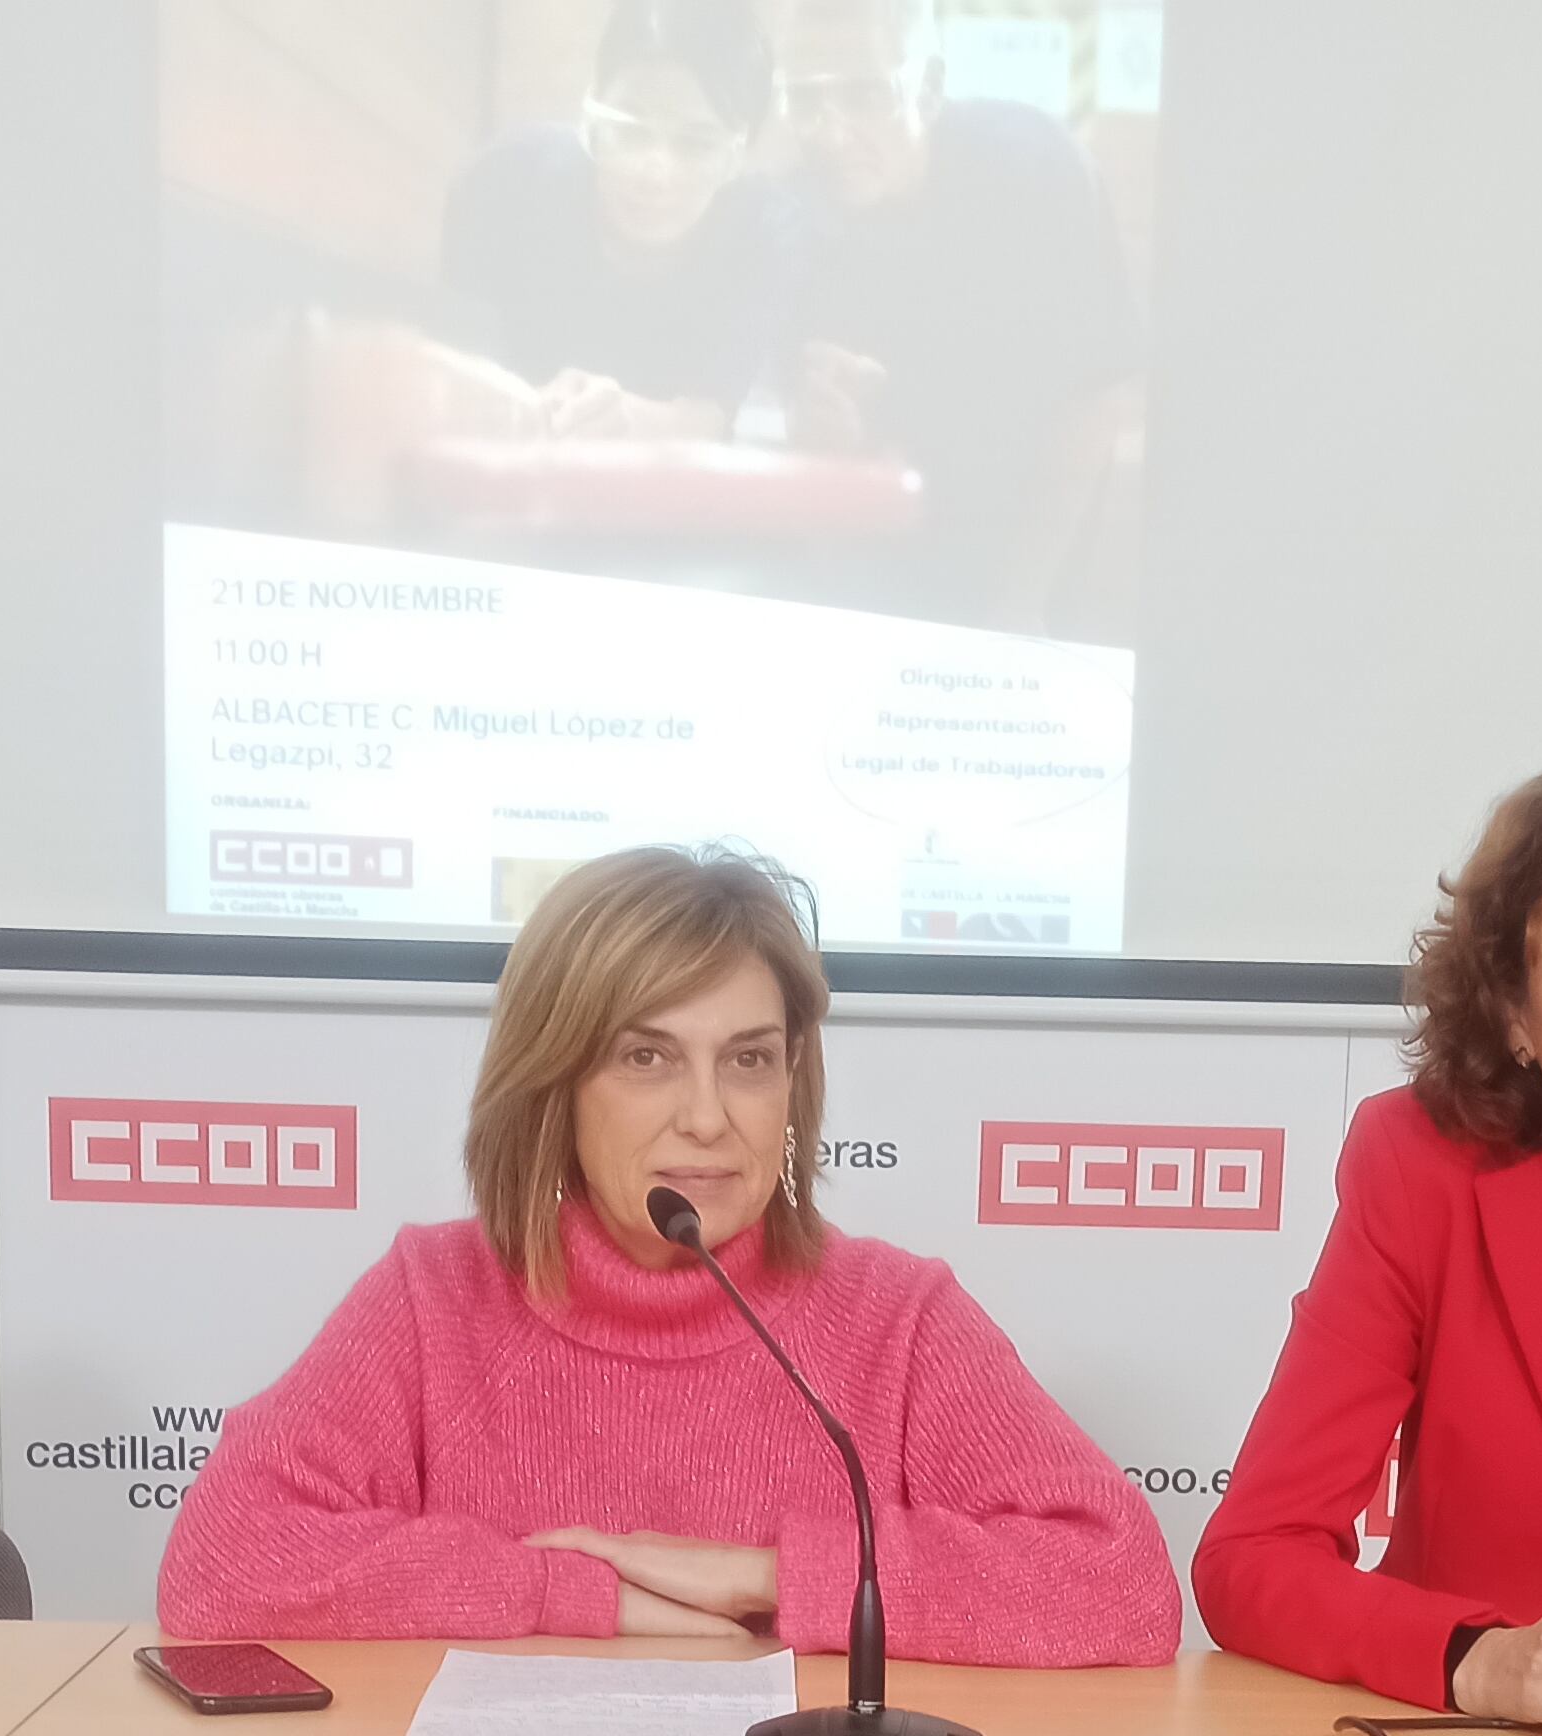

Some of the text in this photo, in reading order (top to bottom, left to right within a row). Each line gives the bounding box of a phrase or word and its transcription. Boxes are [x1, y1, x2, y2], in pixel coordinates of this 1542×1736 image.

[254, 578, 297, 607] DE
[308, 580, 504, 614] NOVIEMBRE
[300, 640, 322, 668] H
[211, 697, 380, 730] ALBACETE
[432, 703, 538, 740] Miguel
[656, 711, 695, 740] de
[354, 741, 394, 770] 32
[217, 838, 350, 876] CCOO
[71, 1120, 337, 1187] CCOO
[1000, 1144, 1263, 1209] CCOO
